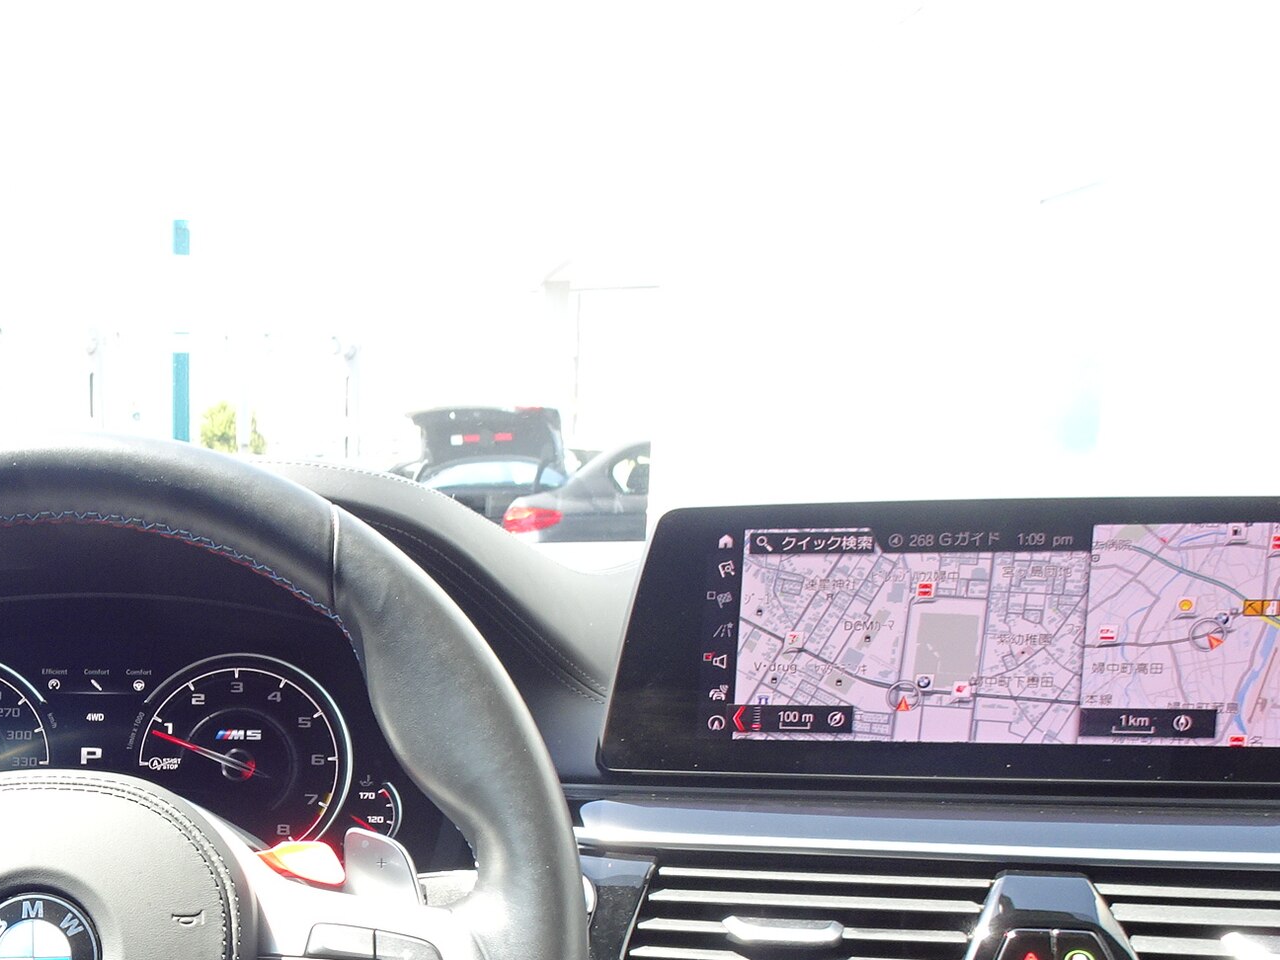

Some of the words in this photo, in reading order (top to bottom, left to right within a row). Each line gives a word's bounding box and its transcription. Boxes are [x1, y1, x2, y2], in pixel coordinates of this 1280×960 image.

[781, 535, 873, 551] クイック検索
[908, 534, 934, 547] 268
[938, 531, 1001, 547] Gガイド
[1017, 532, 1046, 547] 1:09
[1052, 534, 1074, 548] pm
[843, 620, 895, 632] DCMカーマ
[83, 668, 110, 676] Comfort
[125, 668, 153, 676] Comfort
[230, 682, 244, 693] 3
[191, 693, 205, 705] 2
[267, 691, 282, 703] 4
[85, 712, 105, 722] 4WD
[298, 716, 312, 728] 5
[778, 711, 799, 723] 100
[802, 713, 814, 723] m
[163, 722, 174, 735] 1
[6, 730, 33, 741] 300
[11, 757, 38, 767] 330
[80, 747, 103, 765] P
[311, 753, 325, 766] 6
[304, 794, 319, 805] 7
[358, 791, 376, 800] 170
[366, 815, 384, 824] 120
[276, 824, 291, 836] 8
